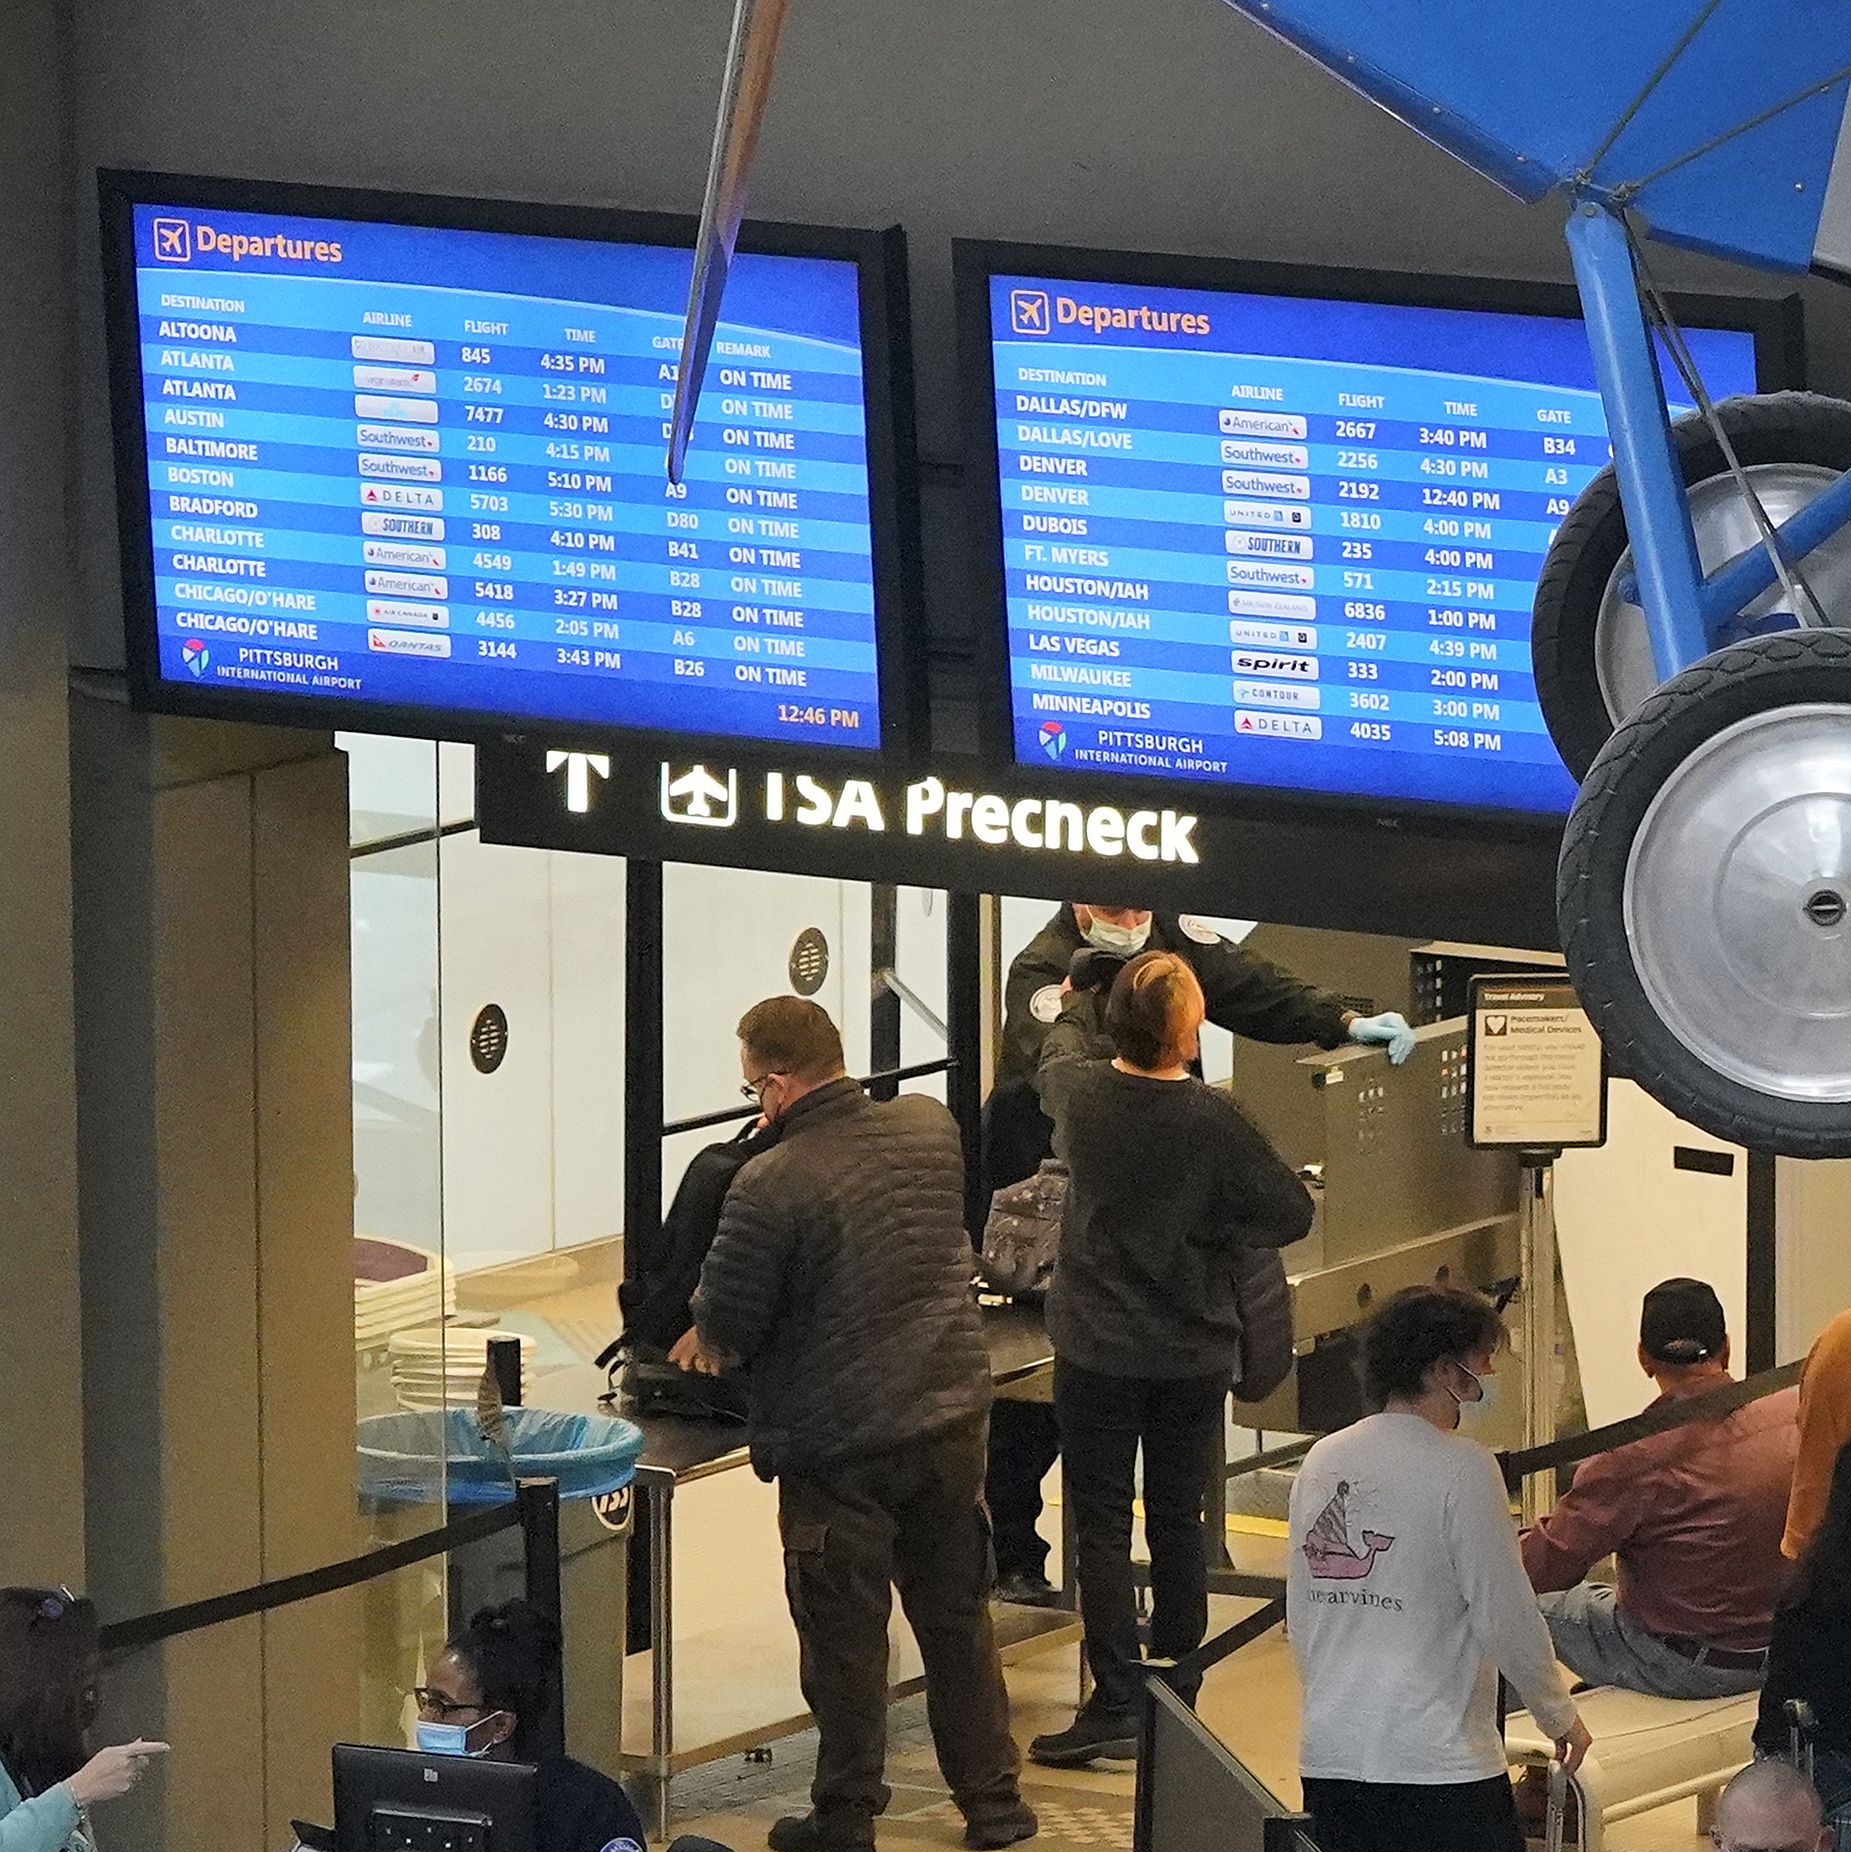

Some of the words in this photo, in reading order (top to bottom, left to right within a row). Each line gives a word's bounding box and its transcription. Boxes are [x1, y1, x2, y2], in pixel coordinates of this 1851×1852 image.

[196, 225, 343, 263] Departures
[161, 293, 245, 313] DESTINATION
[362, 311, 412, 328] AIRLINE
[464, 319, 508, 335] FLIGHT
[564, 328, 596, 343] TIME
[1056, 297, 1211, 335] Departures
[160, 321, 236, 341] ALTOONA
[462, 347, 490, 363] 845
[162, 351, 234, 371] ATLANTA
[465, 377, 501, 393] 2674
[163, 380, 235, 400] ATLANTA
[466, 406, 503, 423] 7477
[1017, 396, 1126, 419] DALLAS/DFW
[165, 409, 223, 427] AUSTIN
[468, 436, 495, 451] 210
[1018, 425, 1132, 449] DALLAS/LOVE
[166, 438, 257, 460] BALTIMORE
[469, 466, 506, 482] 1166
[1020, 456, 1087, 476] DENVER
[169, 467, 233, 487] BOSTON
[471, 494, 507, 511] 5703
[551, 502, 583, 518] 5:30
[588, 505, 612, 520] PM
[667, 512, 699, 529] D80
[729, 518, 754, 534] ON
[758, 520, 799, 538] TIME
[1022, 486, 1089, 505] DENVER
[170, 496, 257, 517] BRADFORD
[473, 524, 500, 539] 308
[1024, 515, 1087, 534] DUBOIS
[171, 525, 264, 547] CHARLOTTE
[474, 553, 511, 570] 4549
[1024, 544, 1048, 561] FT.
[1051, 547, 1109, 566] MYERS
[173, 554, 265, 576] CHARLOTTE
[476, 582, 513, 599] 5418
[1027, 575, 1148, 600] HOUSTON/IAH
[175, 584, 315, 610] CHICAGO/O'HARE
[477, 612, 514, 629] 4456
[1028, 605, 1150, 629] HOUSTON/IAH
[177, 613, 317, 639] CHICAGO/O'HARE
[479, 641, 516, 658] 3144
[239, 647, 339, 671] PITTSBURGH
[1029, 634, 1064, 651] LAS
[1067, 637, 1120, 656] VEGAS
[1235, 654, 1311, 676] spirit
[216, 665, 309, 685] INTERNATIONAL
[312, 675, 362, 690] AIRPORT
[1031, 664, 1131, 687] MILWAUKEE
[778, 704, 826, 725] 12:46
[830, 708, 859, 728] PM
[1033, 694, 1150, 718] MINNEAPOLIS
[1259, 717, 1313, 735] DELTA
[1075, 748, 1172, 768] INTERNATIONAL
[1175, 758, 1228, 773] AIRPORT
[1098, 730, 1203, 754] PITTSBURGH
